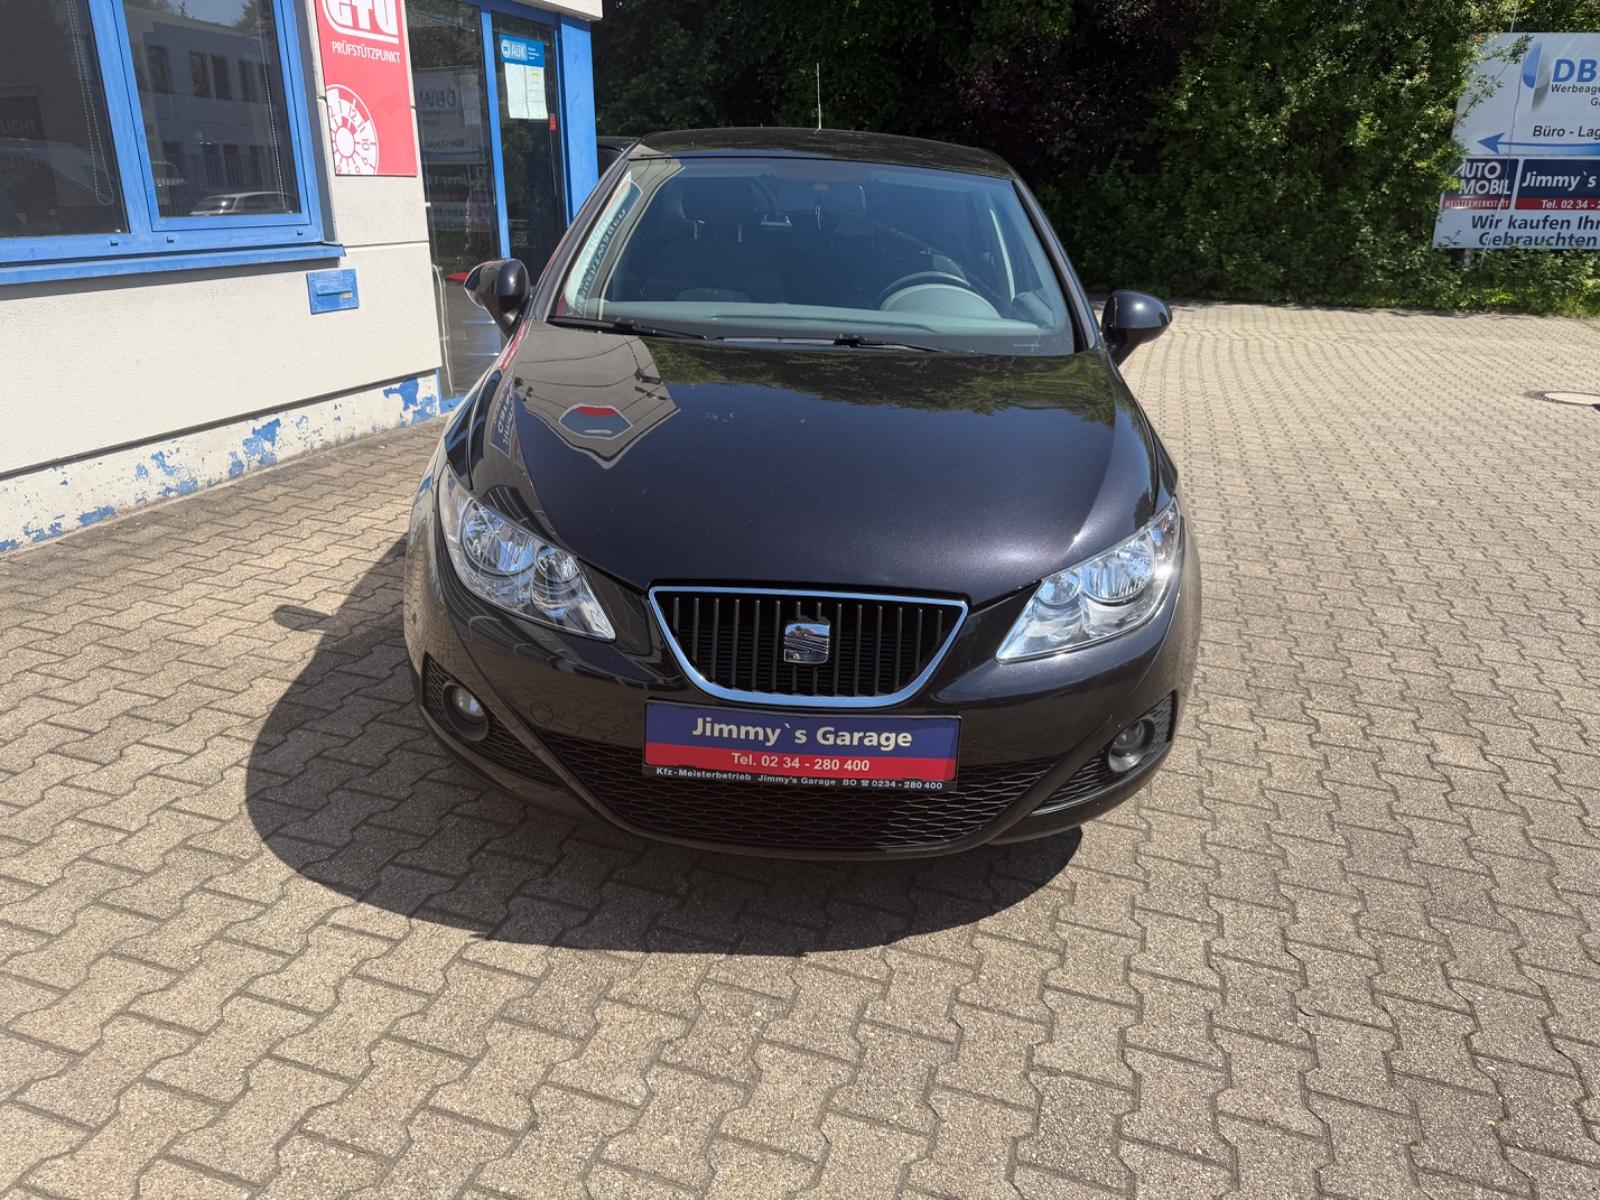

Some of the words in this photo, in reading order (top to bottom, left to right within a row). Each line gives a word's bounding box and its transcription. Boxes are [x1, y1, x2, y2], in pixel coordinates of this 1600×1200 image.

[331, 40, 401, 63] PRÜFSTÜTZPUNKT
[1533, 125, 1565, 137] Büro
[1452, 159, 1501, 178] AUTO
[1459, 179, 1511, 195] MOBIL
[1542, 200, 1556, 209] Tel.
[1561, 200, 1572, 209] 02
[1576, 200, 1588, 209] 34
[1472, 214, 1502, 229] Wir
[1507, 214, 1571, 230] kaufen
[1479, 231, 1598, 247] Gebrauchten
[816, 726, 913, 751] Garage
[731, 752, 756, 766] Tel.
[761, 755, 778, 767] 02
[783, 757, 800, 768] 34
[814, 759, 839, 771] 280
[844, 760, 870, 771] 400
[801, 777, 836, 786] Garage
